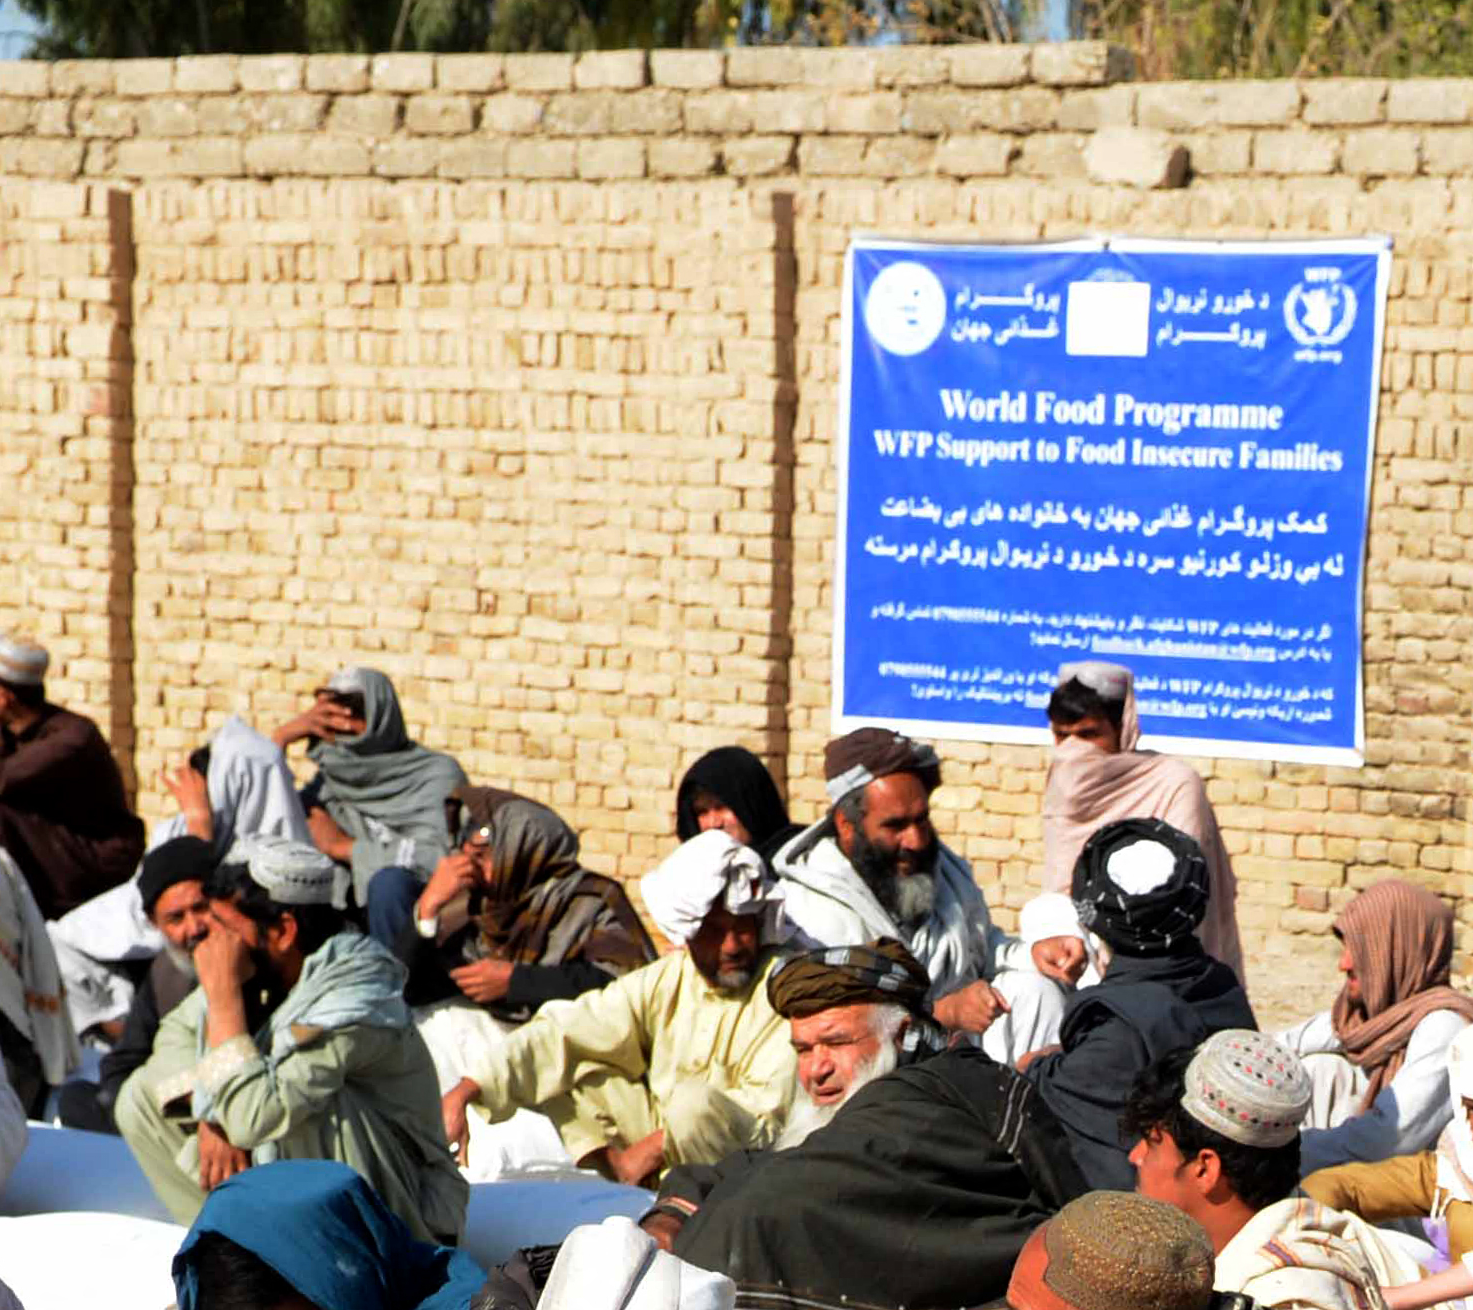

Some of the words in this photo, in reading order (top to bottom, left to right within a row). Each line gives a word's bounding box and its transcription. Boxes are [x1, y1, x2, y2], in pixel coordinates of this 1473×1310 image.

[940, 388, 1028, 424] World
[1035, 391, 1106, 426] Food
[1114, 393, 1284, 436] Programme
[874, 429, 934, 458] WFP
[936, 431, 1030, 467] Support
[1035, 438, 1060, 463] to
[1065, 435, 1126, 465] Food
[1131, 438, 1234, 469] Insecure
[1238, 440, 1343, 472] Families
[880, 495, 942, 524] بضاعت
[1008, 501, 1069, 529] خانواده
[1071, 506, 1092, 531] به
[1094, 503, 1141, 534] جهان
[1277, 511, 1328, 534] کمک
[1186, 619, 1219, 636] WFP
